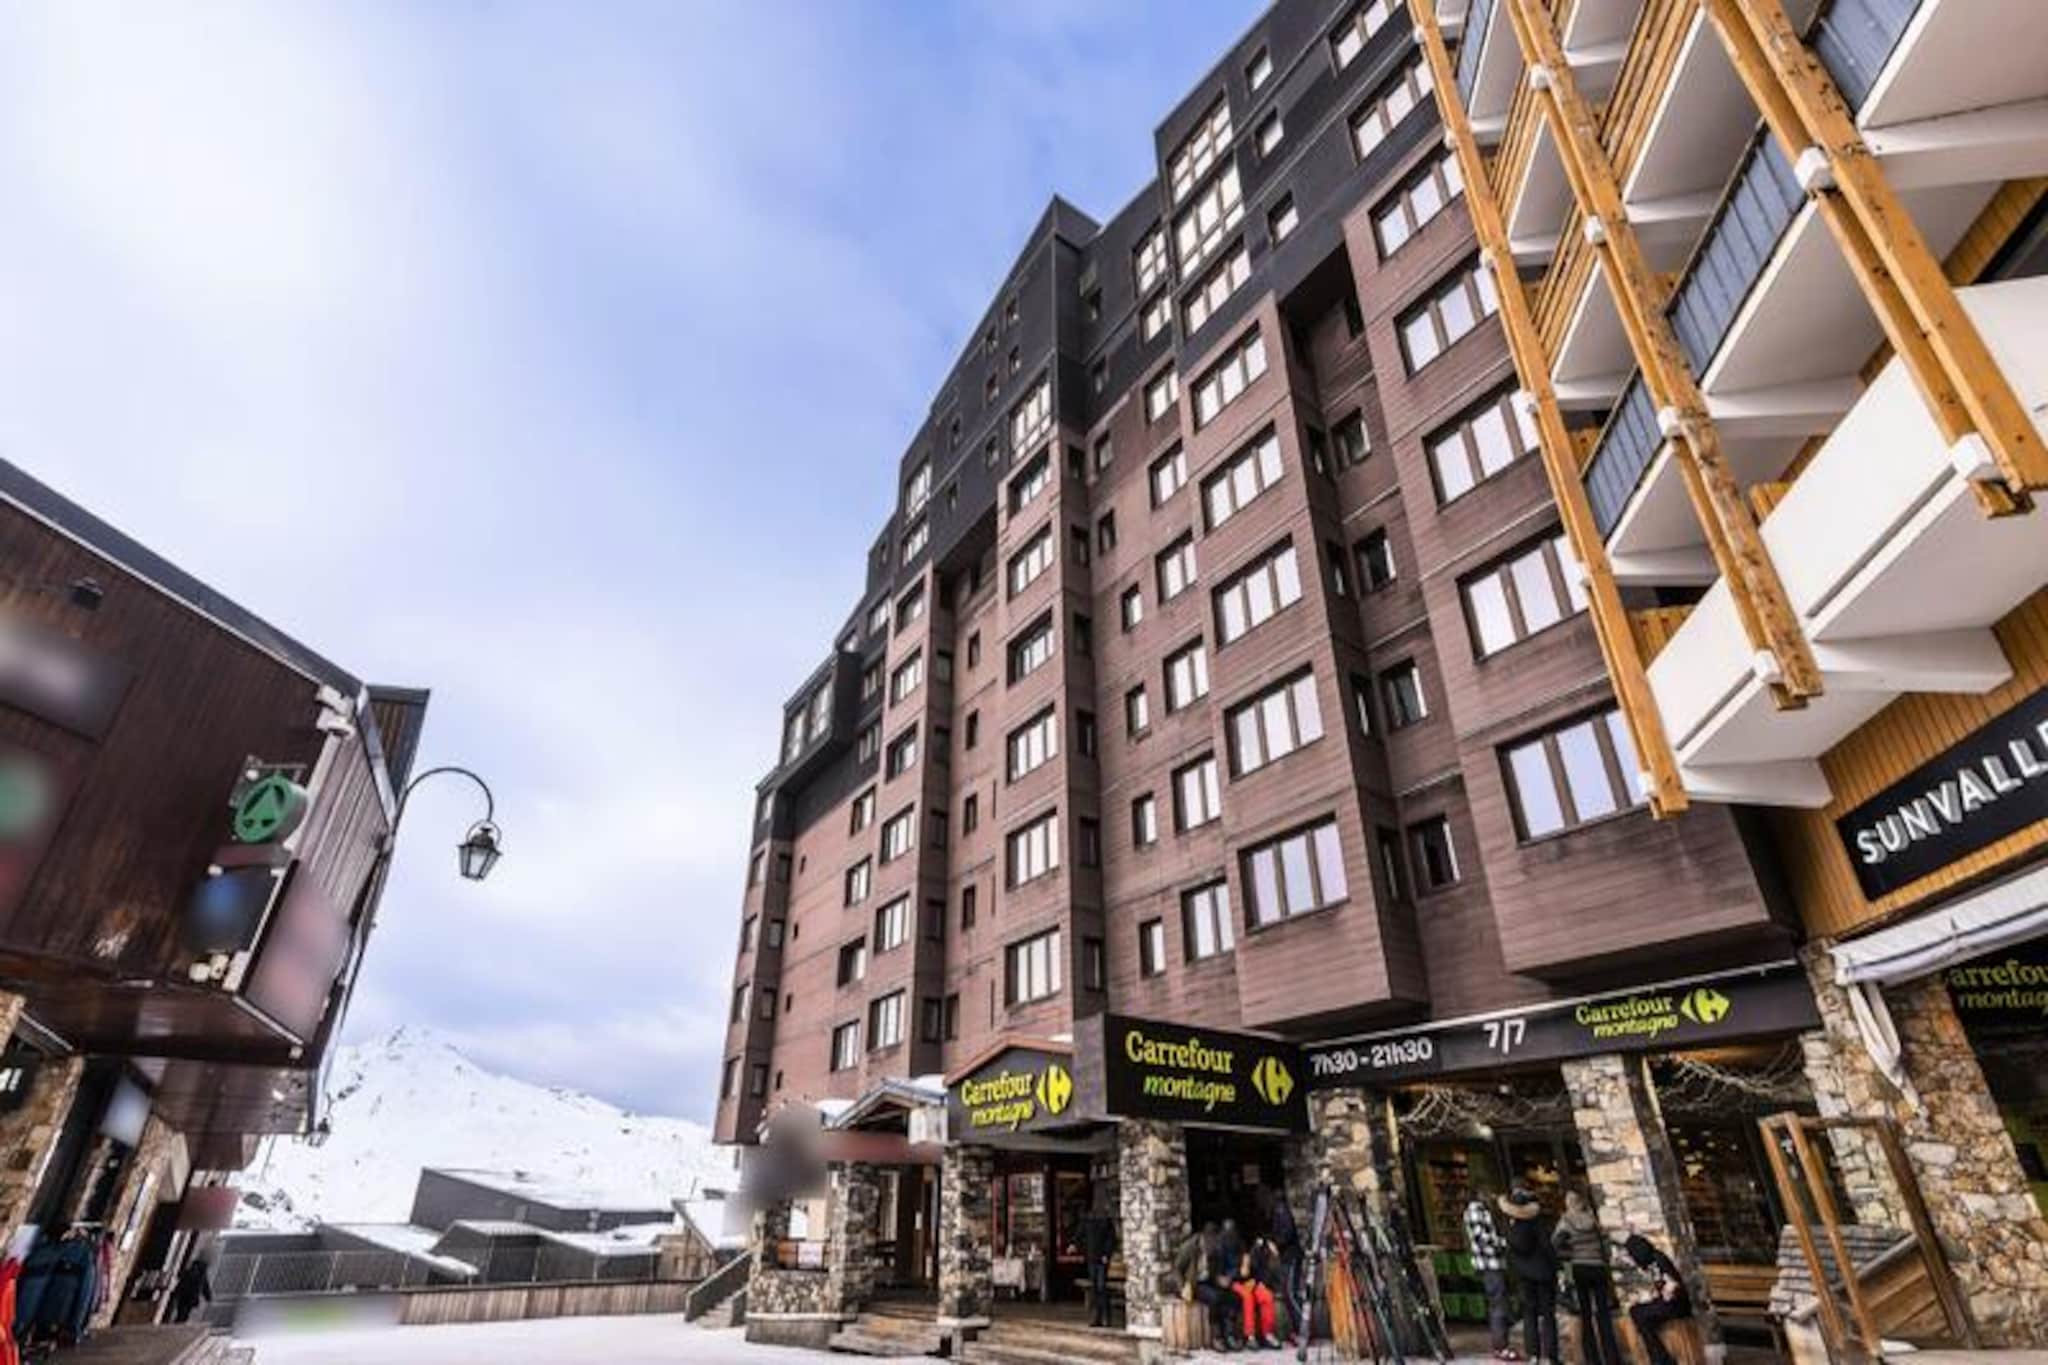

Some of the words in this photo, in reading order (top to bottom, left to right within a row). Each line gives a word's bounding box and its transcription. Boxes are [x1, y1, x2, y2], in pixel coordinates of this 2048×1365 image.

[1576, 996, 1674, 1025] Carrefour
[1593, 1014, 1679, 1039] montagne
[1125, 1031, 1233, 1074] Carrefour
[961, 1070, 1033, 1106] Carrefour
[1143, 1075, 1236, 1113] montagne
[971, 1100, 1034, 1131] montagne
